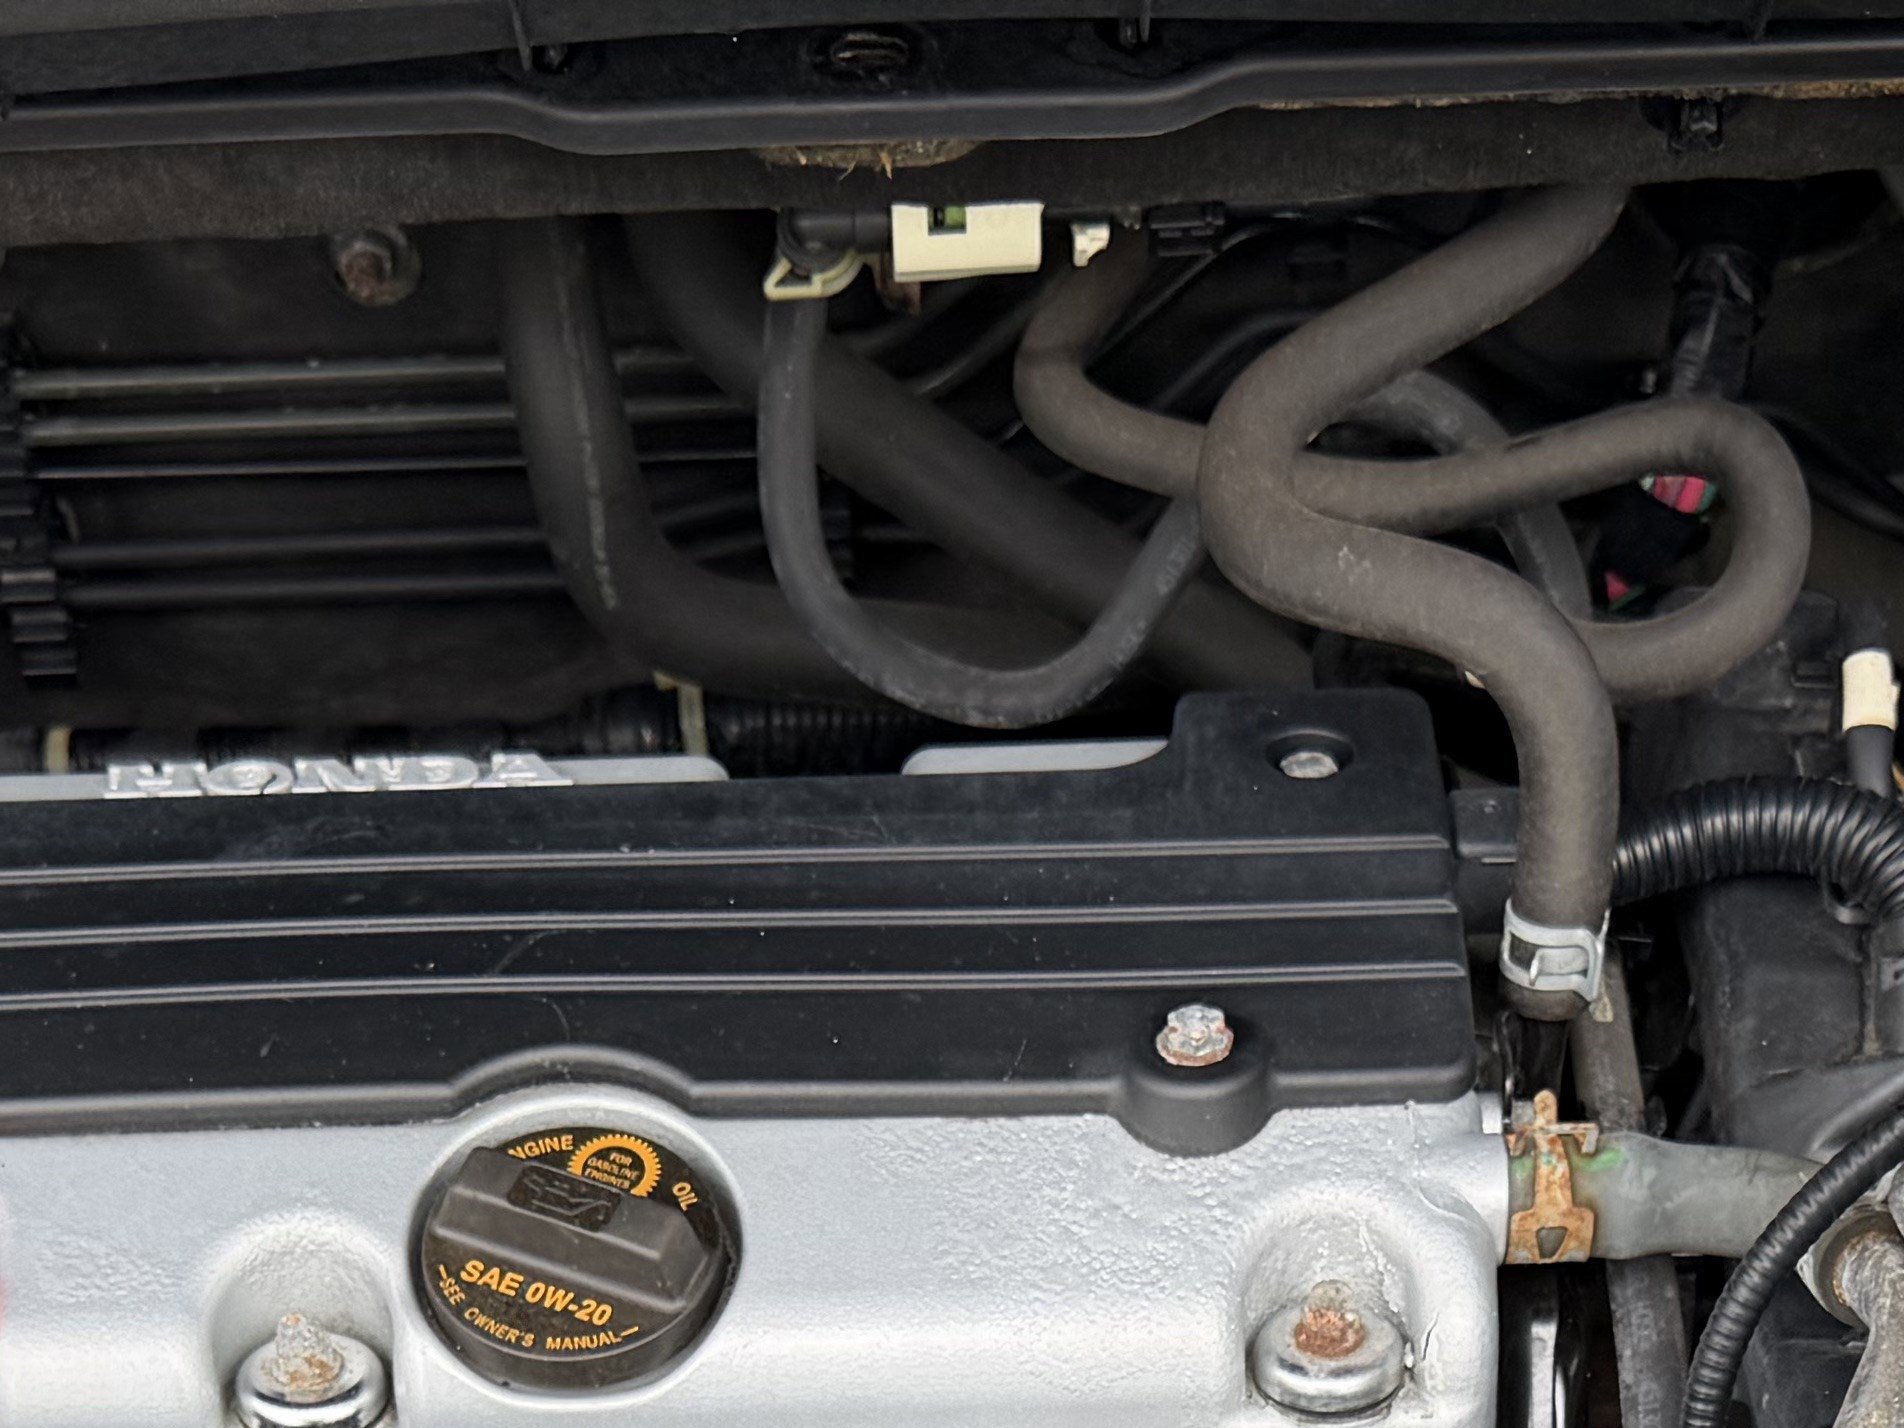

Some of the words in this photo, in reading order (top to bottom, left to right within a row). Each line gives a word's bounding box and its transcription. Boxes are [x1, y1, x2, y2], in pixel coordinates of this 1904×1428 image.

[103, 749, 575, 800] HONDA
[585, 1156, 642, 1181] GASOLINE
[608, 1150, 634, 1167] FOR
[670, 1180, 700, 1213] OIL
[459, 1258, 525, 1299] SAE
[524, 1282, 615, 1328] 0W-20
[463, 1306, 535, 1349] OWNER'S
